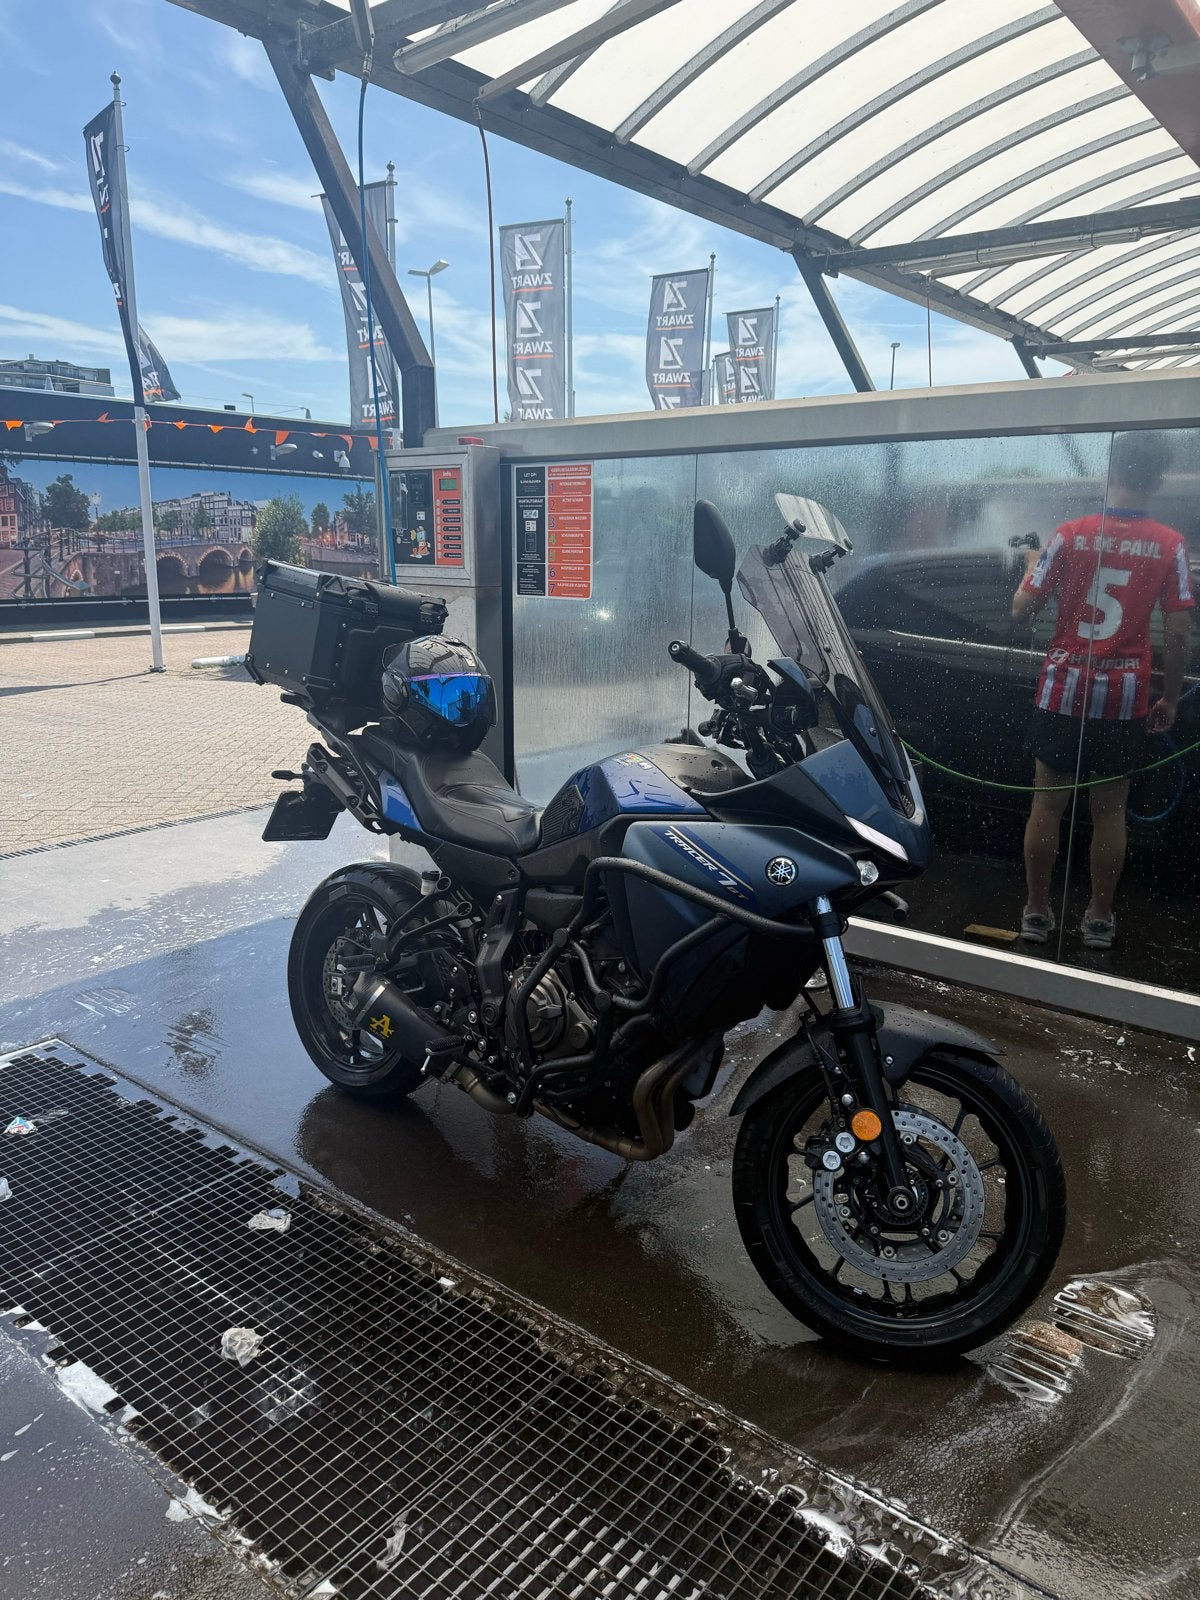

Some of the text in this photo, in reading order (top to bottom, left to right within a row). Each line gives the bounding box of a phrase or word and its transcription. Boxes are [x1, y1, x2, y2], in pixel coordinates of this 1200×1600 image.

[1119, 539, 1162, 559] PAUL
[549, 567, 556, 579] 6
[549, 583, 556, 594] 7
[1077, 566, 1132, 641] 5
[664, 830, 718, 871] TRACER
[718, 871, 738, 886] 7
